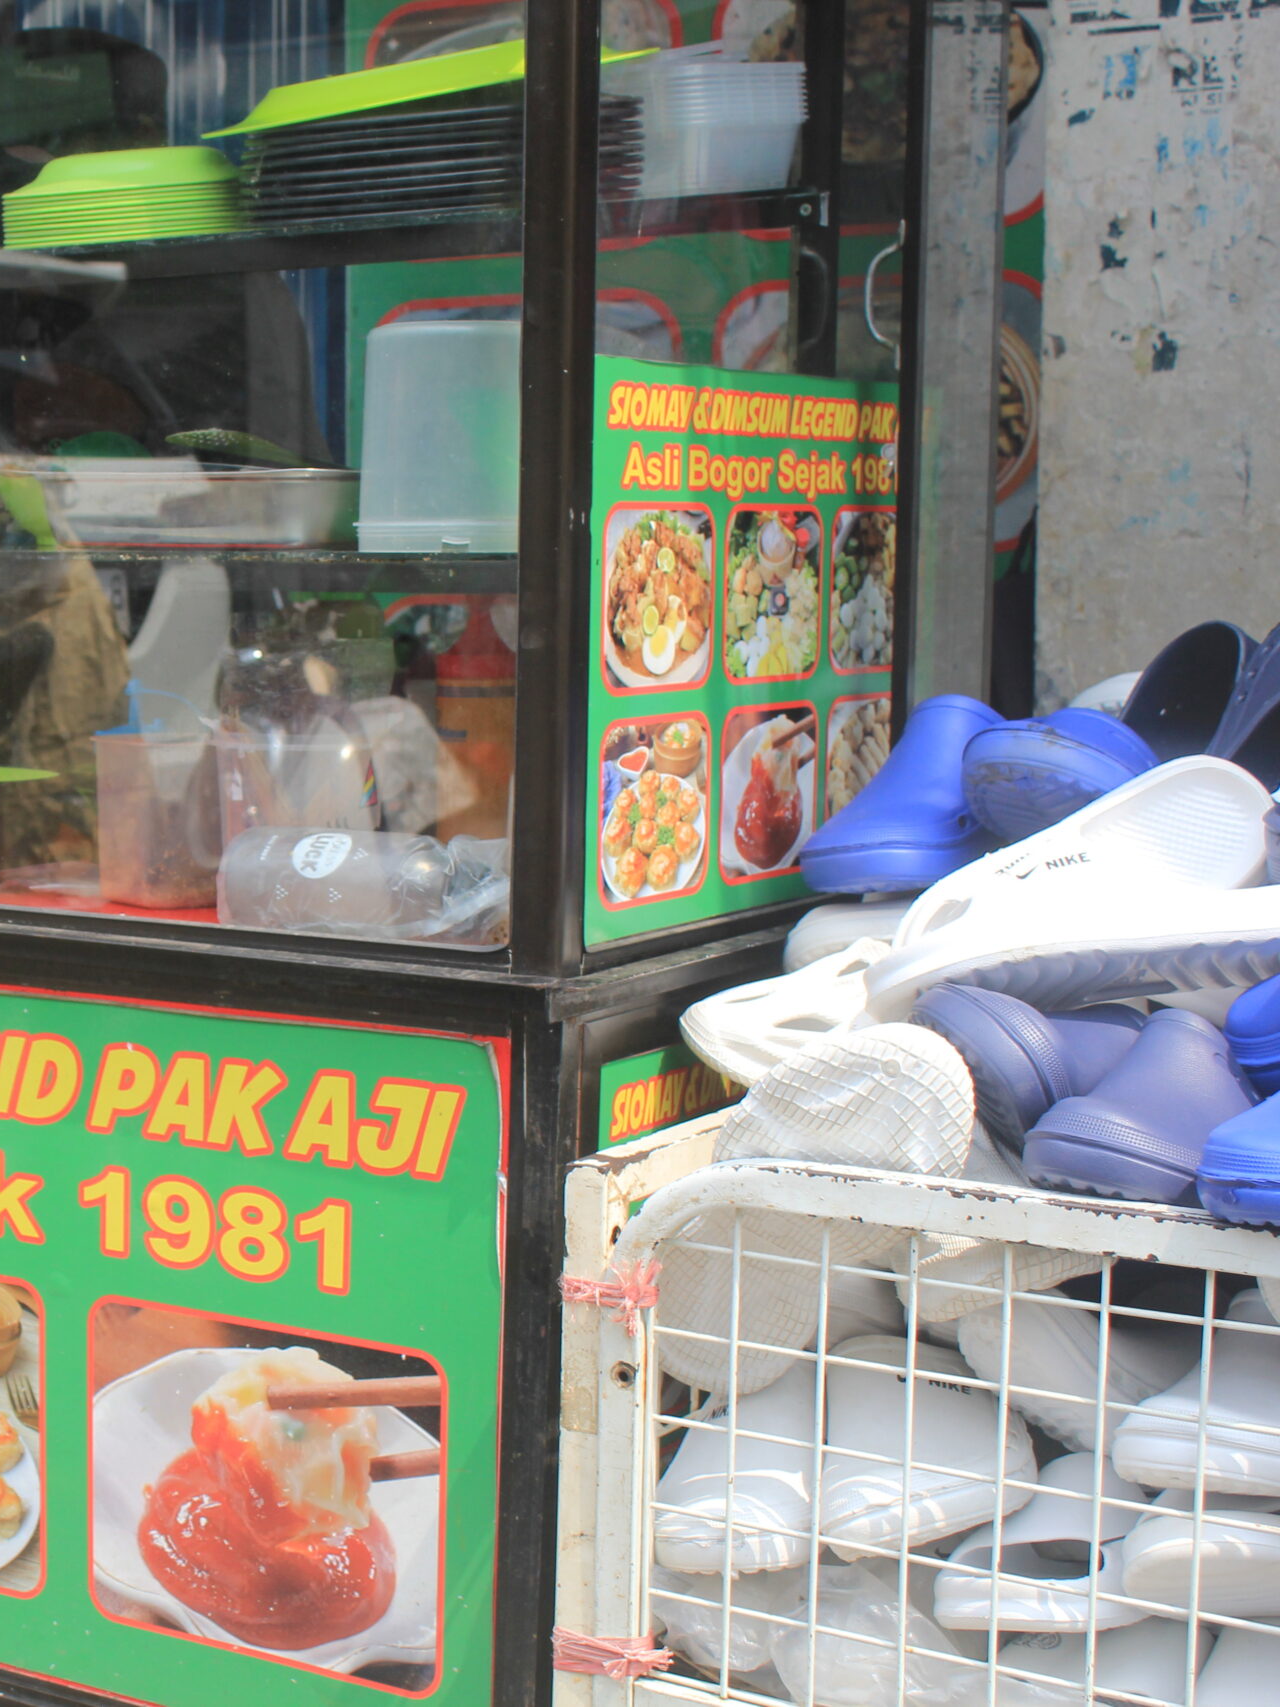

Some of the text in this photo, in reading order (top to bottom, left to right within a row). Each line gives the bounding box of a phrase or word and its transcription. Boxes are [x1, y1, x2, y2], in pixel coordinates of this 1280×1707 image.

[608, 380, 696, 431] SIOMAY
[693, 387, 712, 433] &
[710, 389, 790, 438] DIMSUM
[789, 395, 859, 441] LEGEND
[858, 401, 896, 443] PAK
[622, 441, 682, 490] Asli
[687, 444, 774, 501] Bogor
[776, 449, 847, 502] Sejak
[1044, 851, 1092, 871] NIKE
[85, 1042, 288, 1157] PAK
[282, 1068, 468, 1182] AJI
[609, 1067, 688, 1142] SIOMAY
[77, 1165, 352, 1296] 1981
